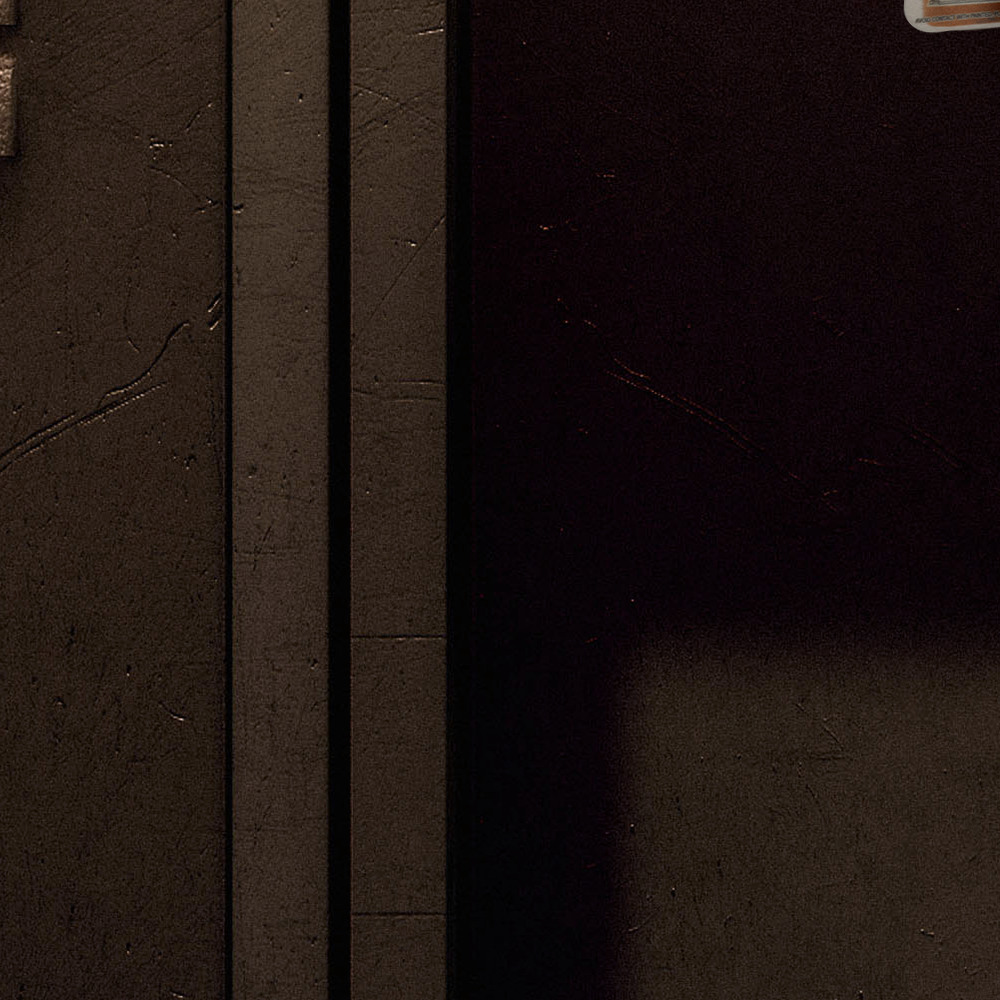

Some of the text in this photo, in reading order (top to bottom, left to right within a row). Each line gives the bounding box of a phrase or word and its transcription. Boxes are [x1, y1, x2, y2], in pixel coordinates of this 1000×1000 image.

[915, 16, 932, 24] AVOID
[932, 14, 956, 23] CONTACT
[957, 13, 970, 21] WITH
